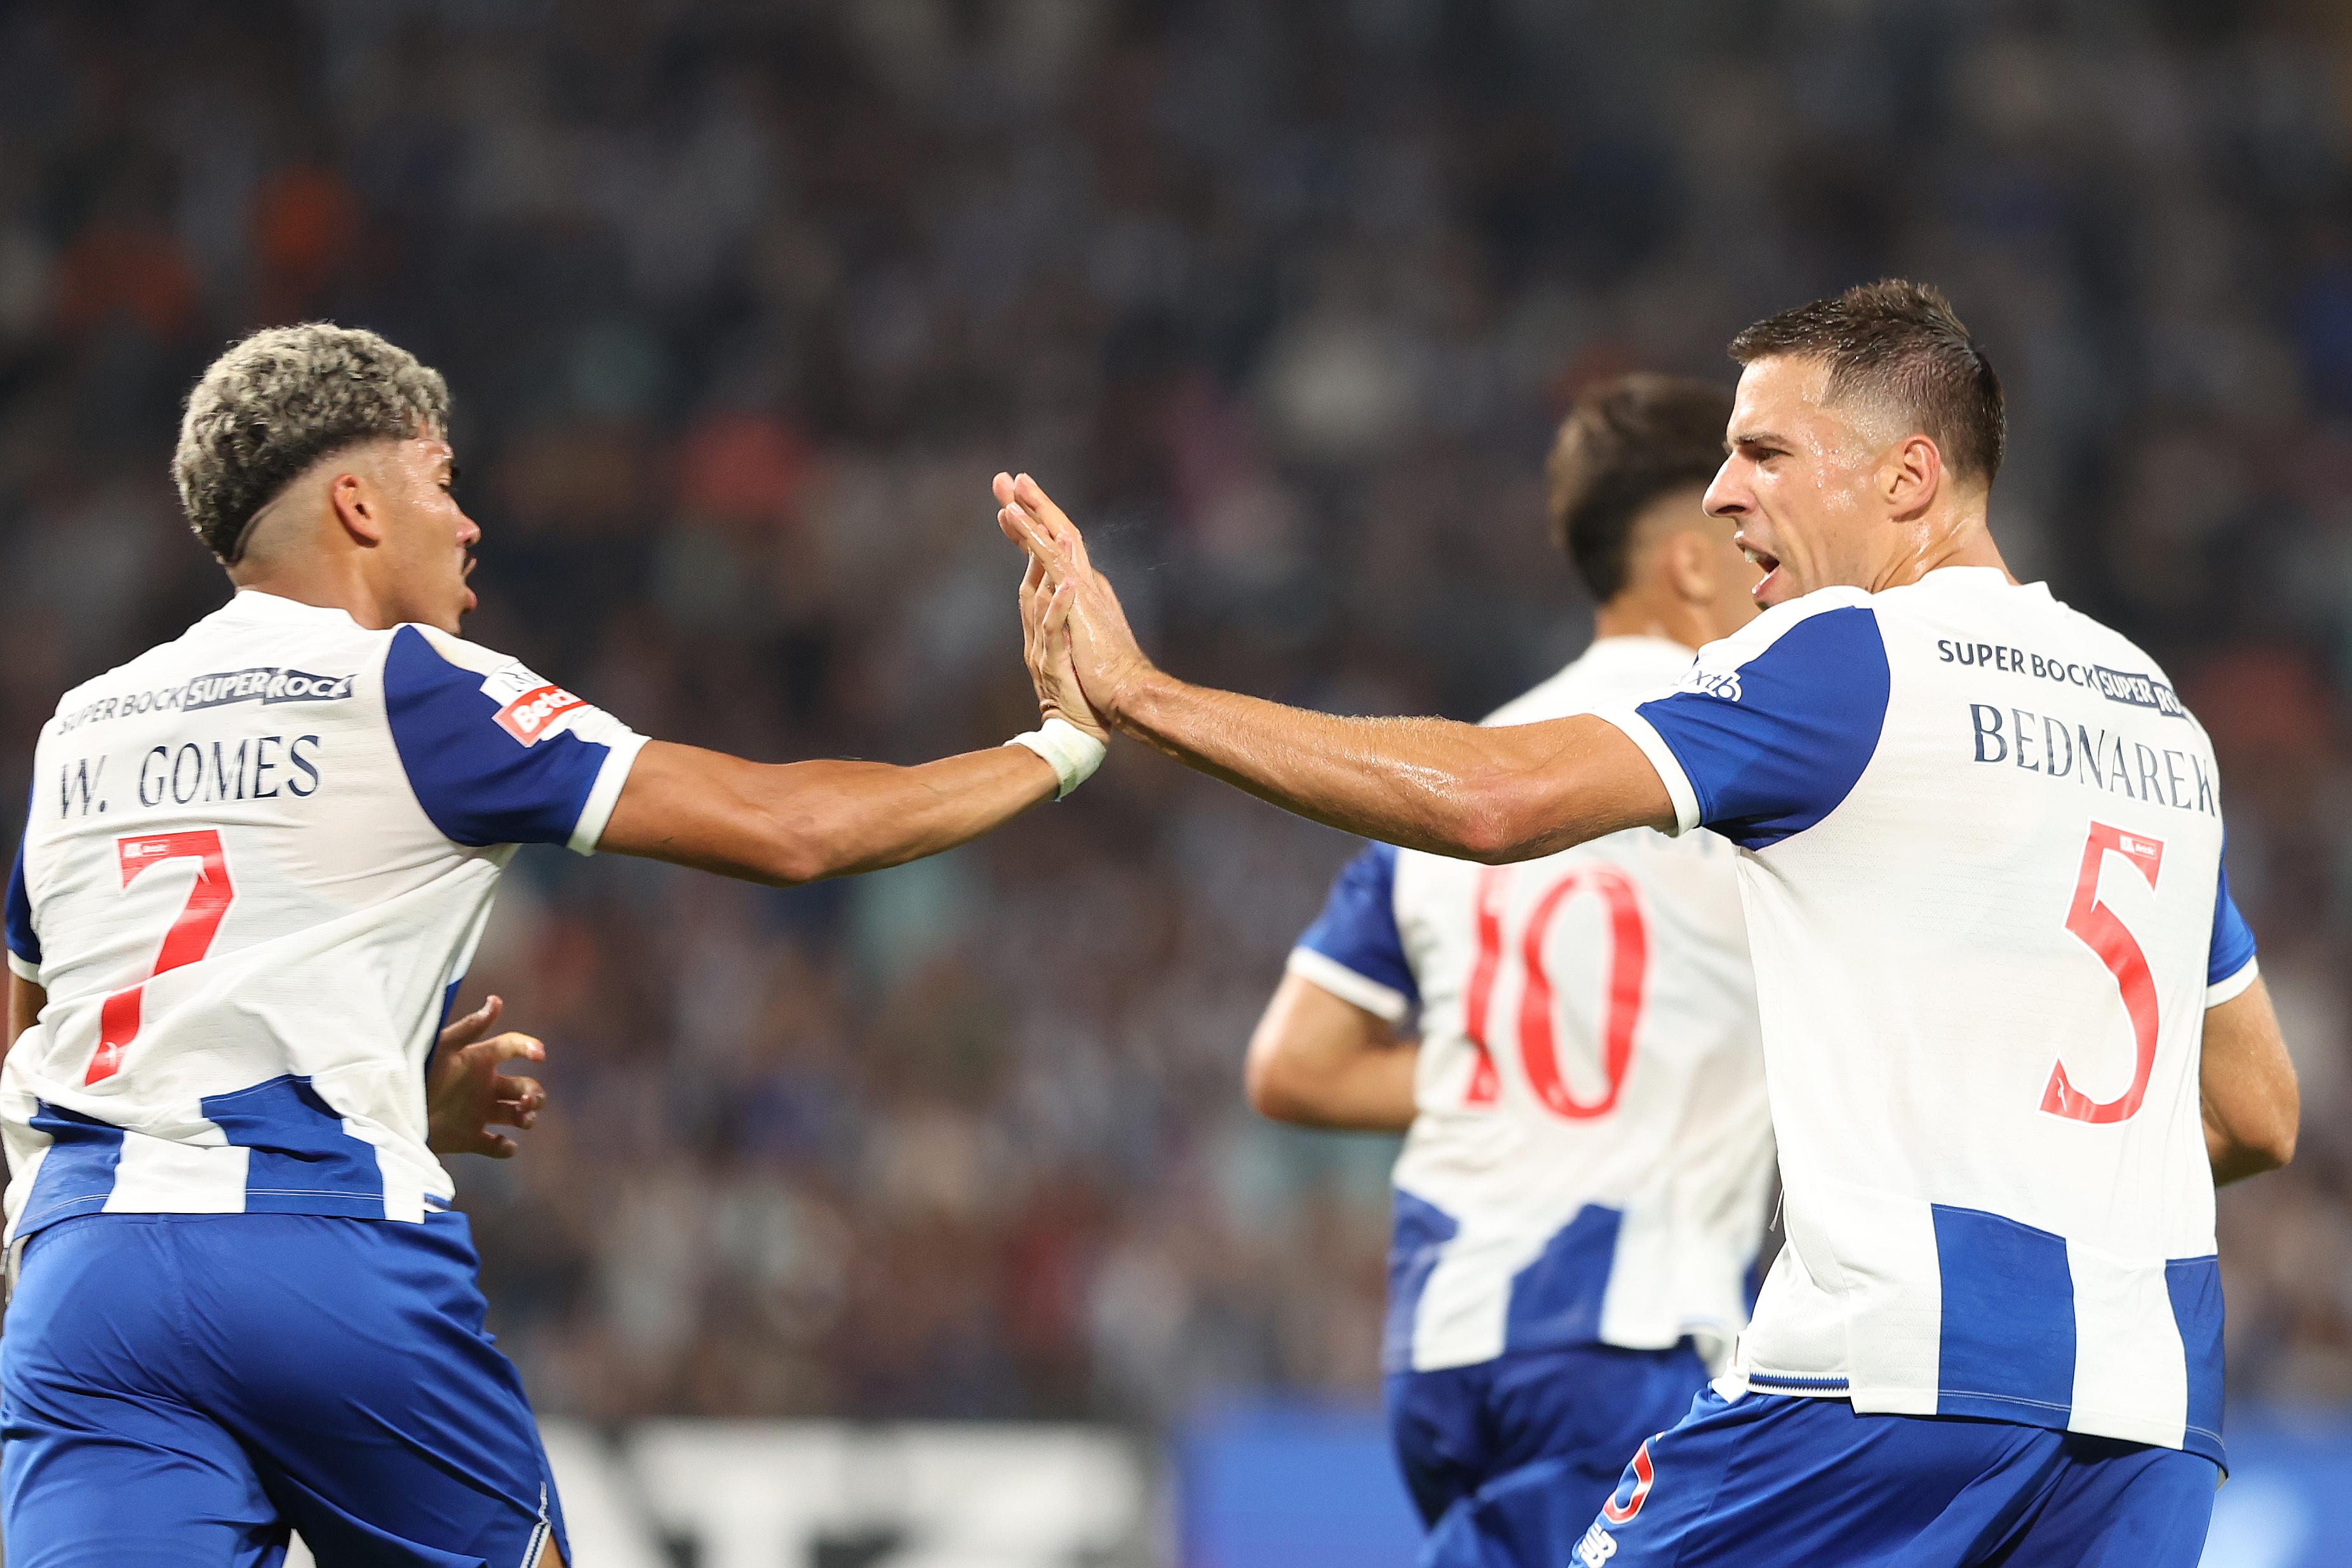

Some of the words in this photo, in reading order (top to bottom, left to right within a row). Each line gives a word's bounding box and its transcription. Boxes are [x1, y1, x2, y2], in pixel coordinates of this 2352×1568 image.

[120, 686, 189, 718] BOCK
[187, 671, 271, 706] SUPER
[265, 670, 354, 699] ROCK
[1937, 639, 2026, 674] SUPER
[2031, 653, 2100, 692] BOCK
[2098, 670, 2156, 704] SUPER
[60, 754, 107, 819] W.
[138, 735, 319, 808] GOMES
[1969, 703, 2216, 818] BEDNAREK
[83, 829, 236, 1088] 7
[1463, 865, 1650, 1119] 10
[2038, 819, 2165, 1124] 5
